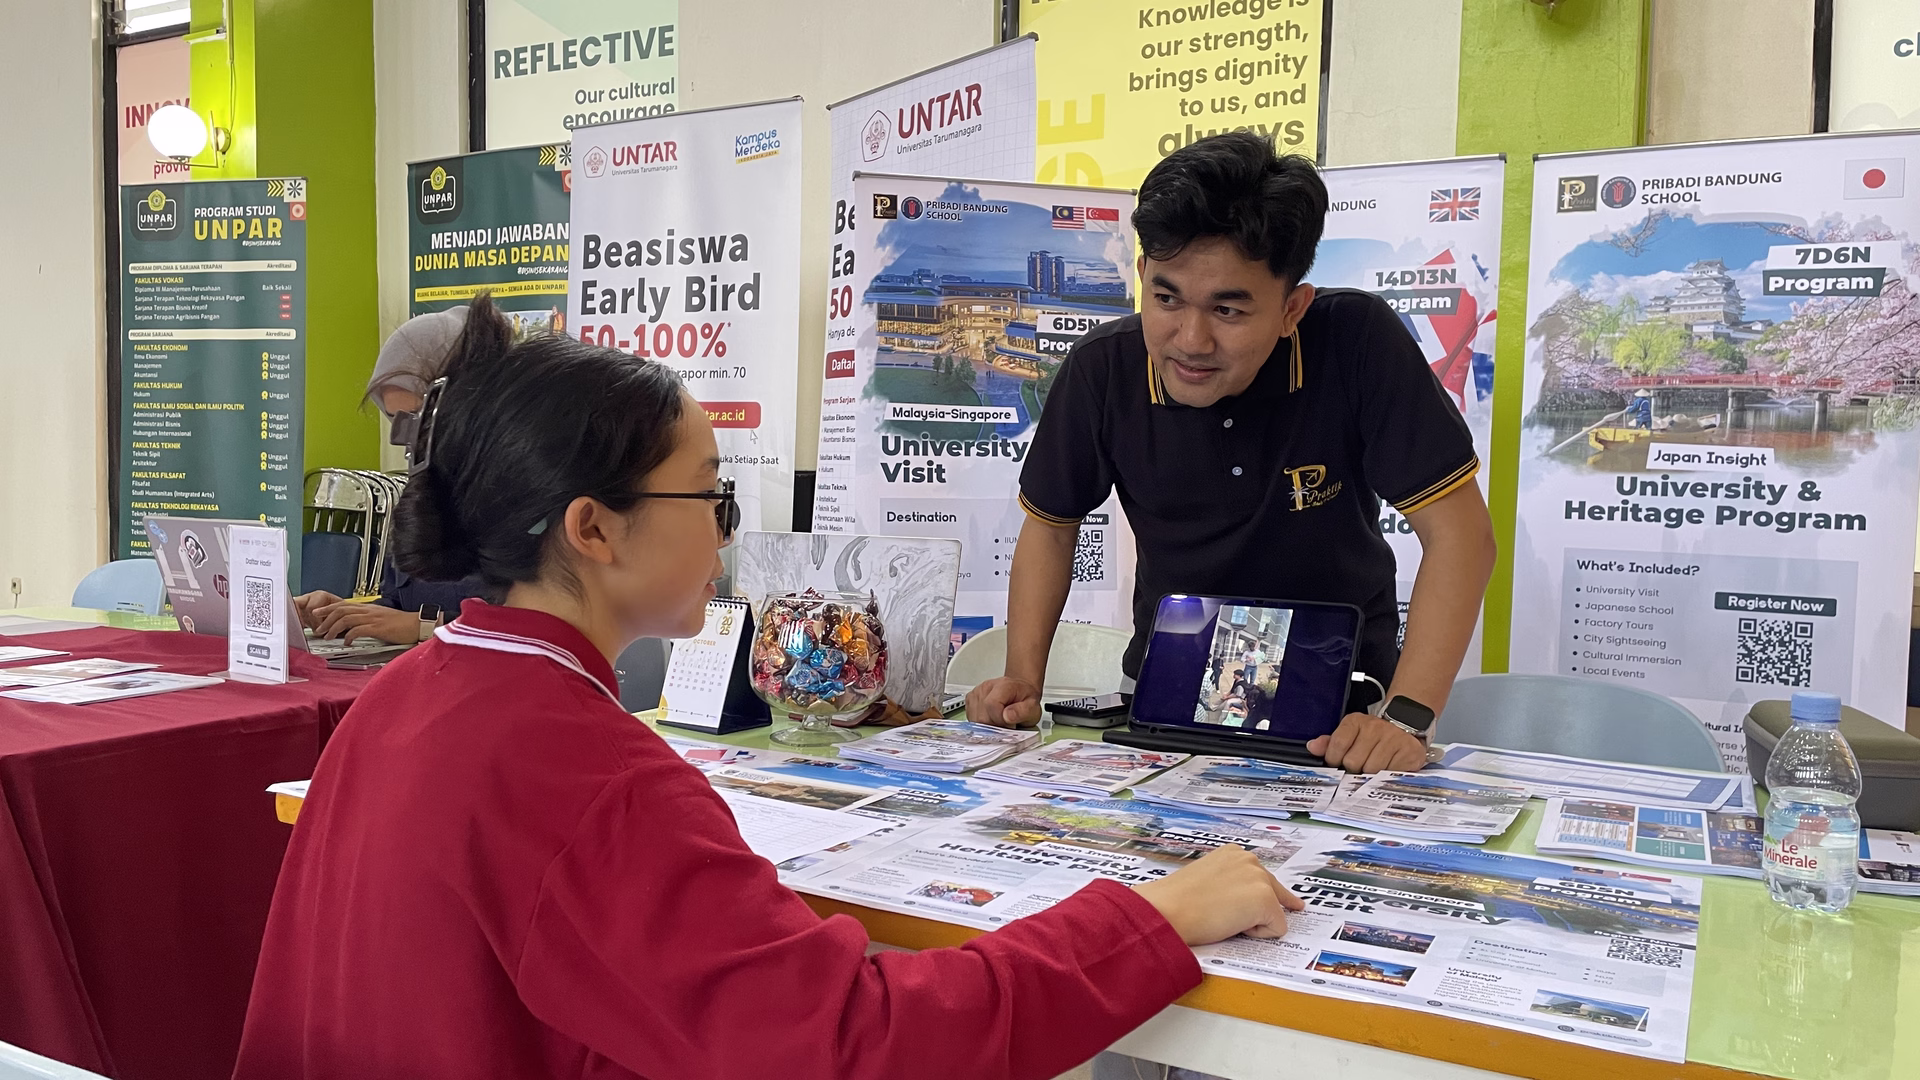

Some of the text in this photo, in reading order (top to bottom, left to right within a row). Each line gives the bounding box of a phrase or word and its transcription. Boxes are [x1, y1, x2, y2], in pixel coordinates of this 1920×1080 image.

[1139, 0, 1283, 29] Knowledge
[1141, 20, 1309, 60] our strength,
[494, 24, 674, 79] REFLECTIVE
[1129, 53, 1308, 92] brings dignity
[575, 77, 674, 105] Our cultural
[1179, 84, 1306, 117] to us, and
[898, 83, 982, 139] UNTAR
[735, 130, 777, 146] Kampus
[897, 123, 982, 154] Universitas Tarumanagara
[613, 141, 677, 166] UNTAR
[735, 140, 780, 157] Merdeka
[1642, 172, 1782, 190] PRIBADI BANDUNG
[425, 193, 452, 205] UNPAR
[926, 201, 1008, 213] PRIBADI BANDUNG
[1642, 192, 1701, 205] SCHOOL
[140, 213, 173, 223] UNPAR
[194, 206, 275, 218] PROGRAM STUDI
[835, 200, 855, 235] Be
[926, 211, 962, 221] SCHOOL
[194, 218, 282, 240] UNPAR
[432, 223, 569, 249] MENJADI JAWABAN
[583, 229, 748, 269] Beasiswa
[1796, 246, 1870, 265] 7D6N
[415, 245, 568, 272] DUNIA MASA DEPAN
[832, 243, 854, 279] Ea
[1376, 268, 1456, 287] 14D13N
[1769, 273, 1873, 295] Program
[581, 273, 760, 323] Early Bird
[830, 285, 852, 320] 50
[1053, 317, 1100, 331] 6D5N
[828, 328, 845, 341] Hanya
[710, 368, 730, 378] min.
[734, 367, 746, 378] 70
[832, 356, 855, 371] Daftar
[892, 407, 1011, 422] Malaysia-Singapore
[881, 433, 1029, 462] University
[735, 455, 758, 465] Setiap
[760, 456, 779, 464] Saat
[1654, 450, 1766, 468] Japan Insight
[880, 460, 946, 483] Visit
[1307, 481, 1342, 502] Praktik
[1616, 474, 1821, 505] University &
[887, 512, 956, 523] Destination
[1564, 500, 1866, 533] Heritage Program
[1577, 560, 1700, 576] What's Included?
[1586, 586, 1659, 597] University Visit
[1585, 602, 1673, 615] Japanese School
[1728, 596, 1824, 612] Register Now
[722, 616, 732, 626] 20
[1585, 618, 1653, 630] Factory Tours
[720, 626, 730, 635] 25
[250, 646, 268, 656] SCAN ME
[1584, 634, 1666, 650] City Sightseeing
[1583, 651, 1682, 665] Cultural Immersion
[1583, 666, 1645, 678] Local Events
[938, 843, 1060, 867] Heritage
[1045, 843, 1137, 862] Japan Insight
[1782, 839, 1798, 853] Le
[994, 844, 1140, 872] University
[1147, 868, 1168, 877] &
[1764, 847, 1817, 869] Minerale
[1303, 877, 1475, 907] Malaysia-Singapore
[1534, 885, 1642, 905] Program
[1291, 884, 1510, 926] University
[1474, 939, 1547, 956] Destination
[1594, 930, 1680, 947] Register Now
[1448, 967, 1502, 980] University
[1460, 972, 1497, 983] Malaya
